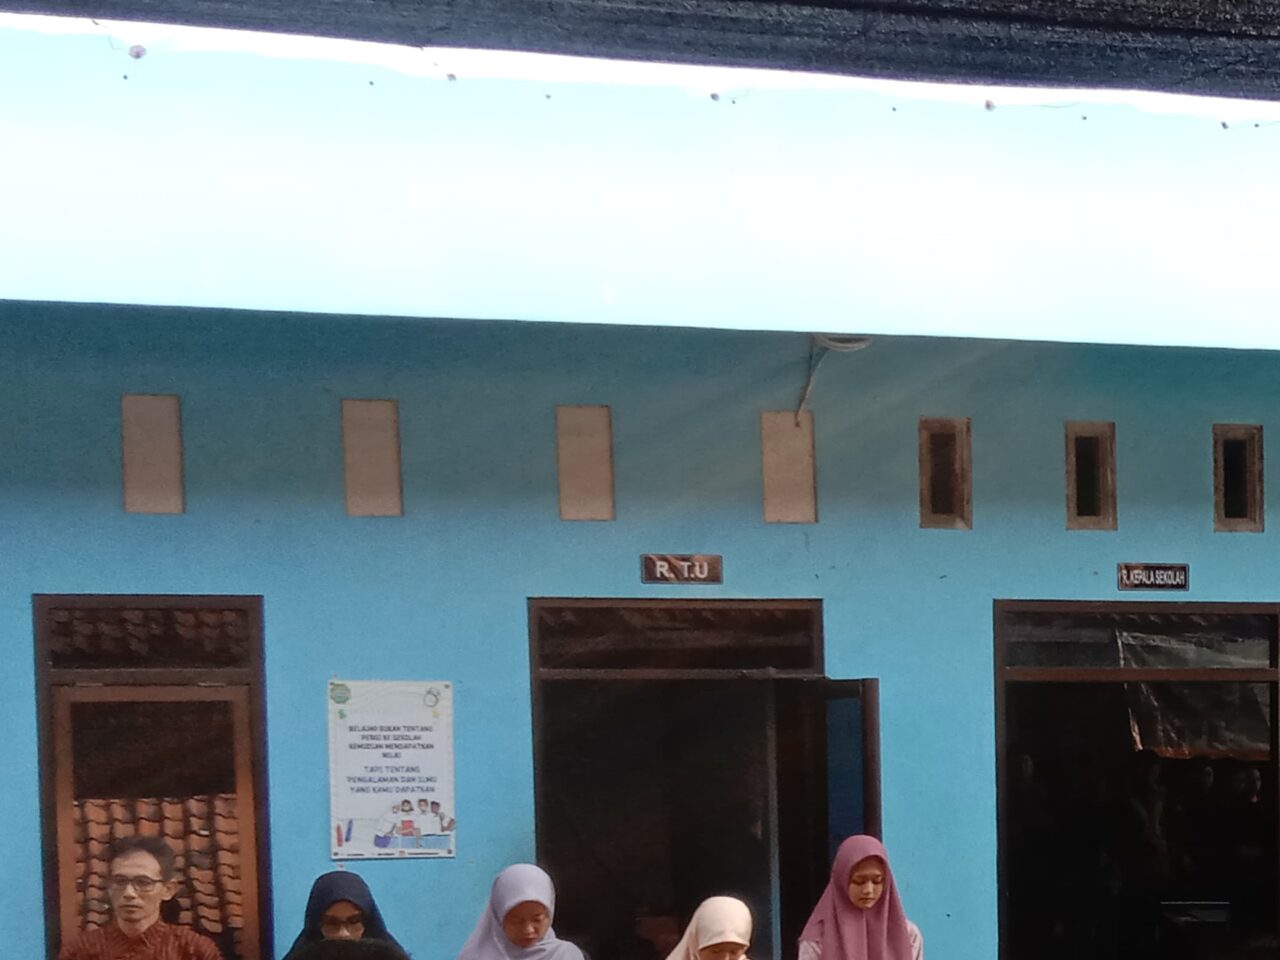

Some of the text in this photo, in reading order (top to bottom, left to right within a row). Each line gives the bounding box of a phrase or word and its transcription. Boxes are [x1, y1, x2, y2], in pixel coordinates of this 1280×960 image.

[656, 560, 709, 579] R. T.U
[1130, 570, 1154, 585] KEPALA
[1155, 570, 1185, 585] SEKOLAH
